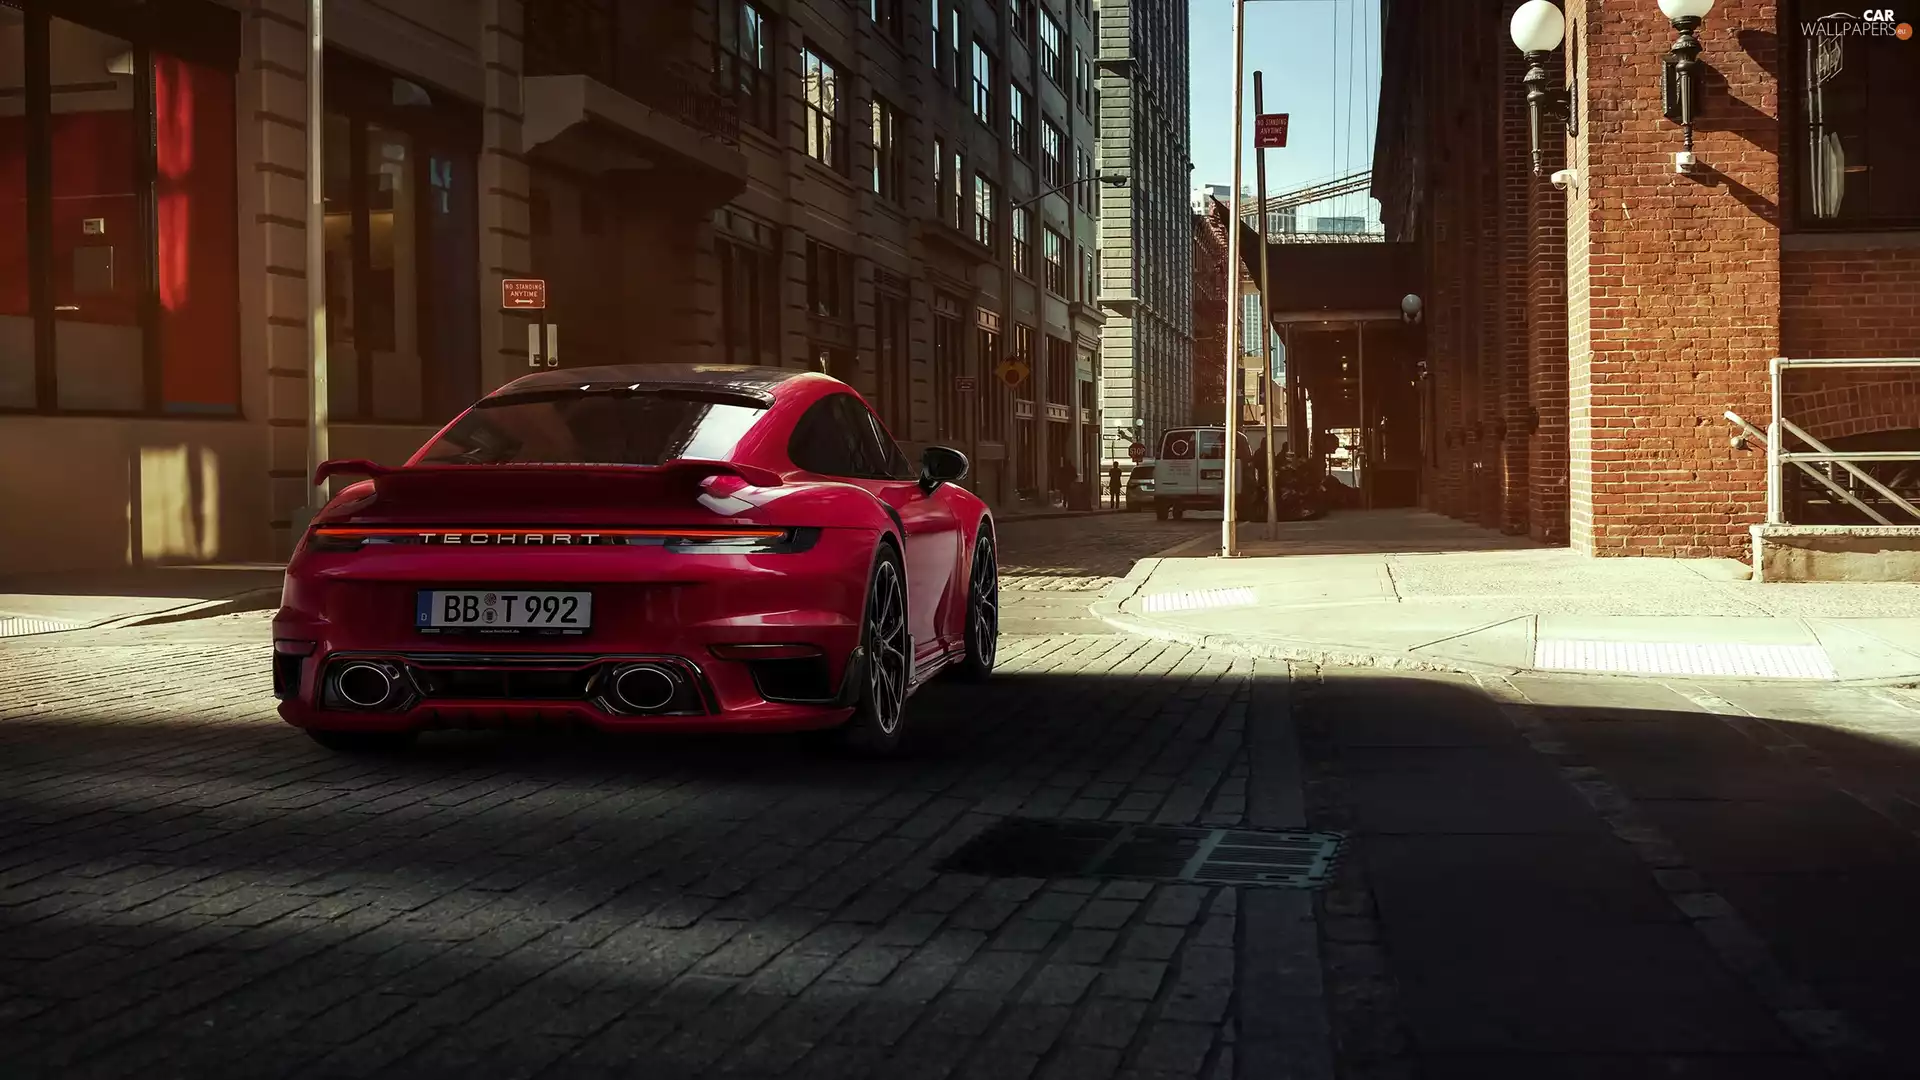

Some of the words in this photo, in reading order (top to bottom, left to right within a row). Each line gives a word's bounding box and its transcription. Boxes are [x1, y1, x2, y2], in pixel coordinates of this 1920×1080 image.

[1260, 127, 1282, 135] ANYTIME
[1130, 447, 1145, 456] STOP
[418, 533, 600, 544] TECHART
[444, 595, 479, 622] BB
[501, 595, 518, 623] T
[525, 595, 578, 624] 992
